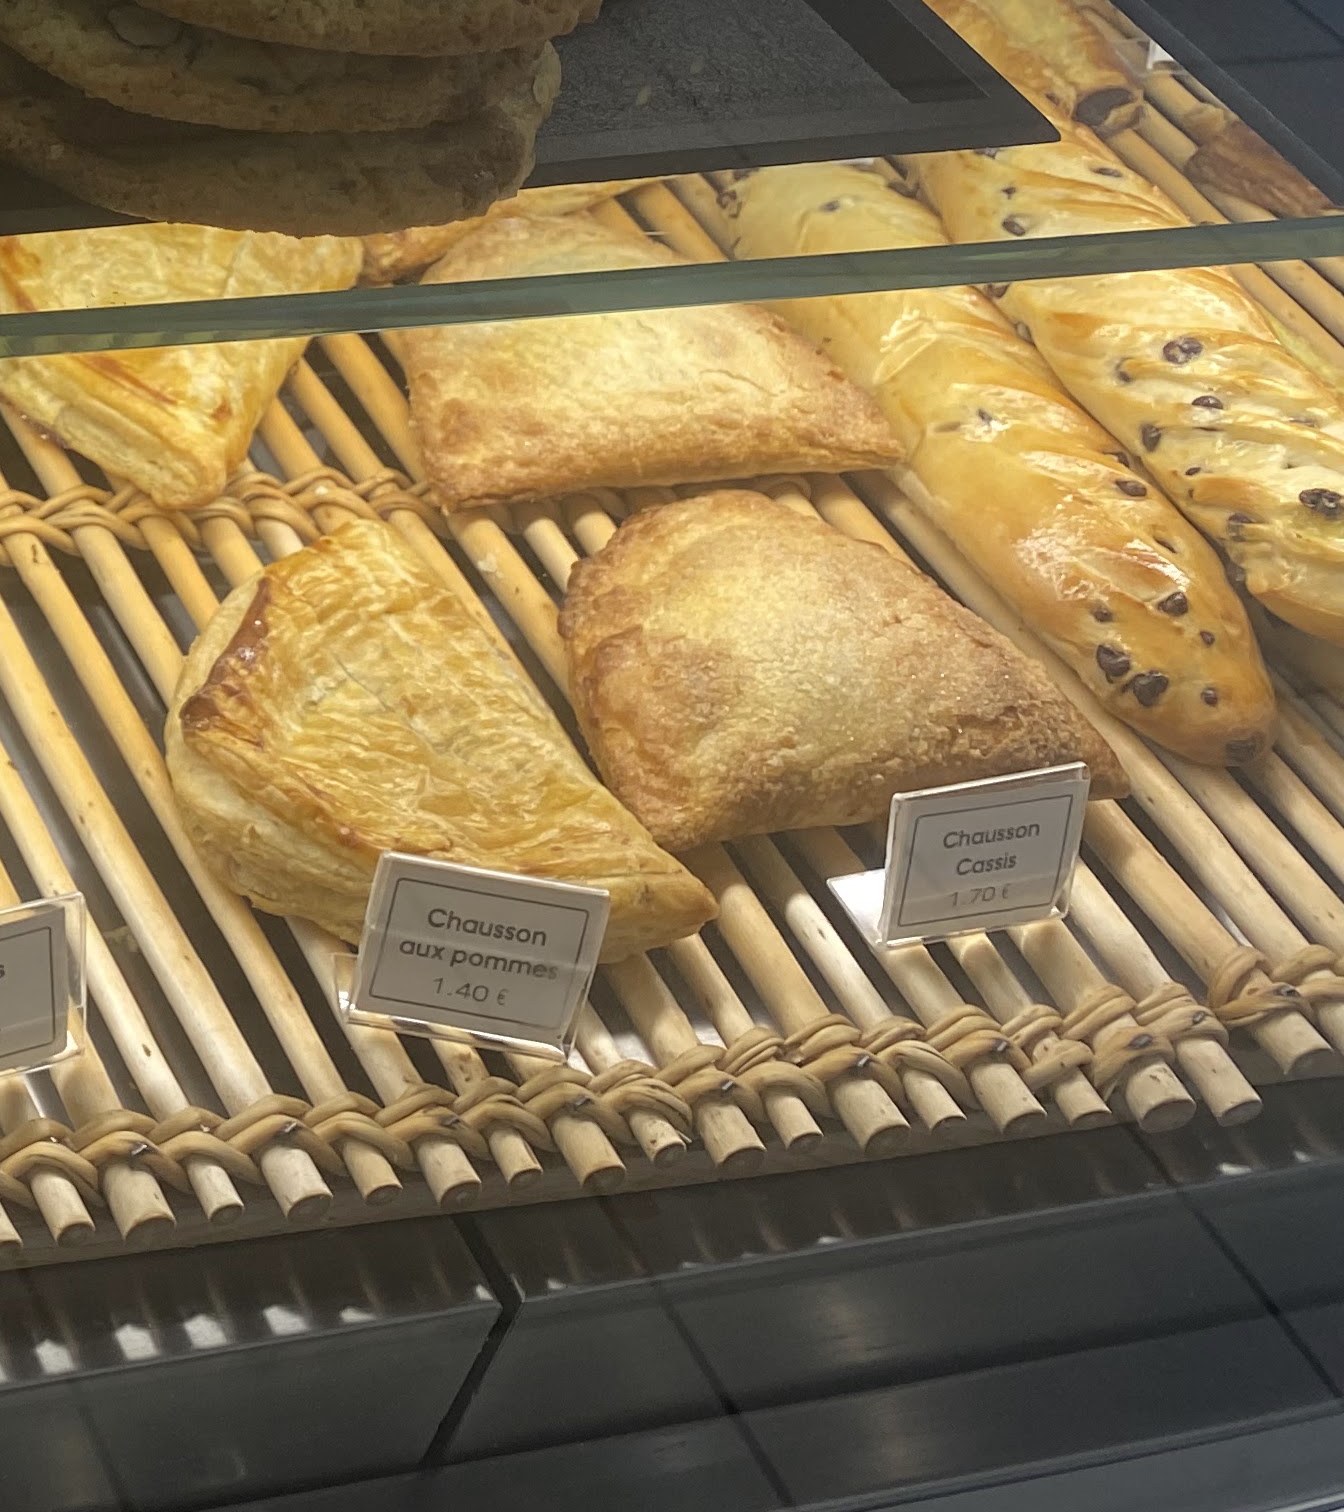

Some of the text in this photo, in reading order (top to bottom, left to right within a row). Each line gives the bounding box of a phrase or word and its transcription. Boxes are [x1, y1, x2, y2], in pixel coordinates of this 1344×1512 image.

[943, 822, 1041, 849] Chausson
[956, 852, 1017, 876] Cassis
[427, 908, 548, 947] Chausson
[399, 939, 560, 981] aux pommes
[433, 977, 489, 1003] 1.40
